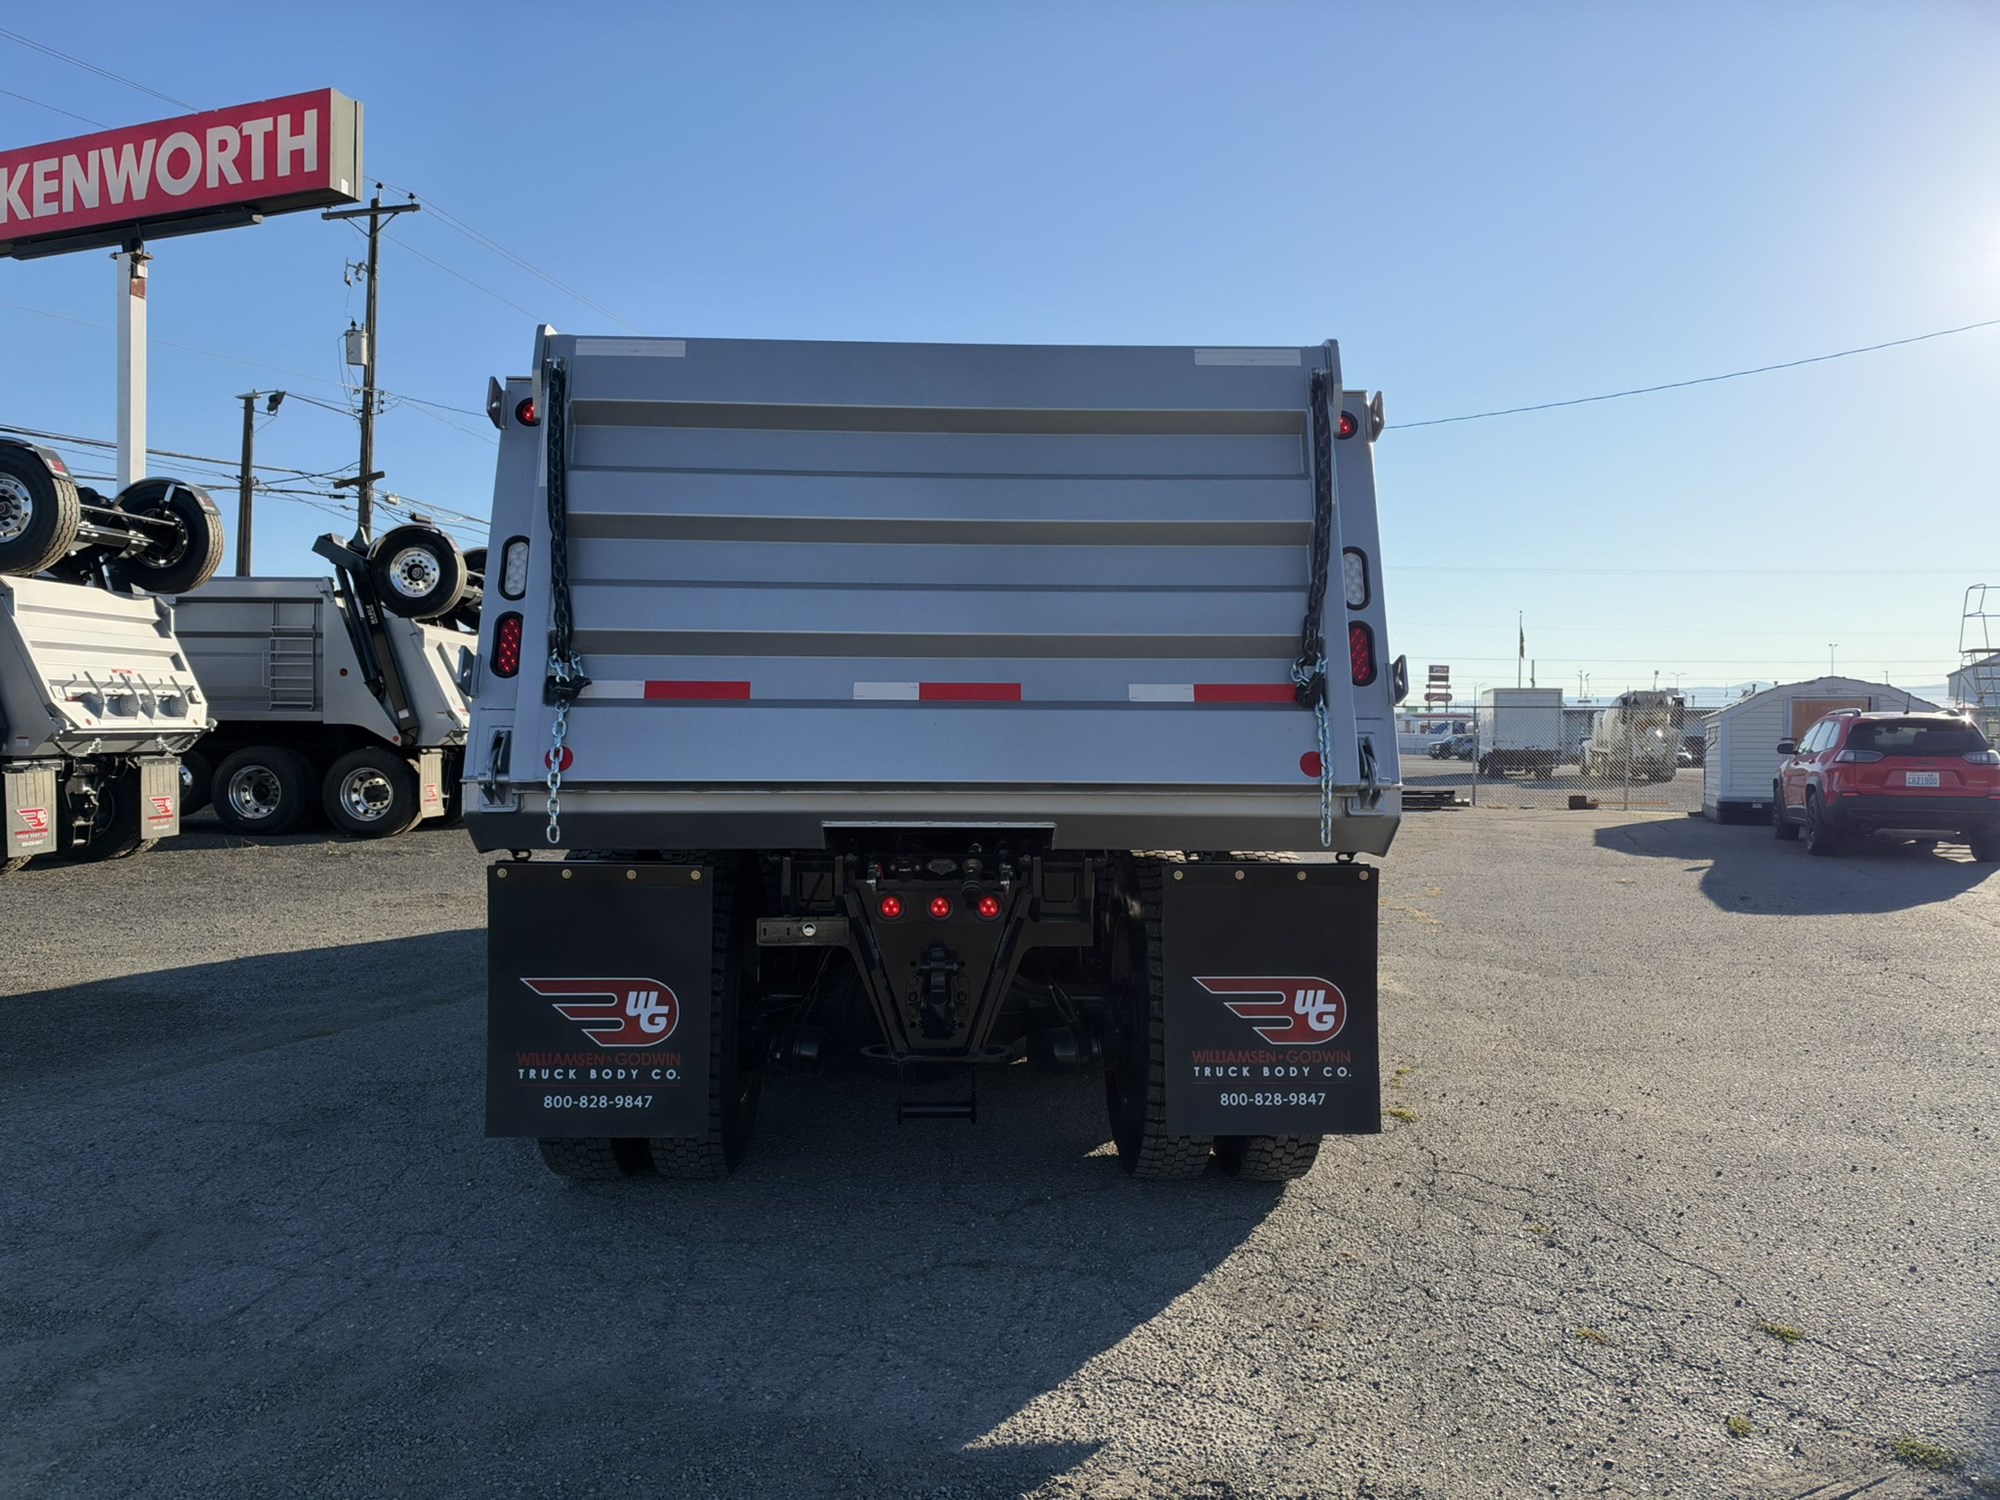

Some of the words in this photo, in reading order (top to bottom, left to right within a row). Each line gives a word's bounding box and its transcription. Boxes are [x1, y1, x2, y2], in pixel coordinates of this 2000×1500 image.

[0, 108, 319, 224] KENWORTH
[518, 1068, 577, 1080] TRUCK
[590, 1068, 639, 1080] BODY
[651, 1068, 681, 1080] CO.
[1193, 1066, 1250, 1077] TRUCK
[1263, 1066, 1311, 1077] BODY
[1323, 1066, 1352, 1077] CO.
[543, 1095, 653, 1108] 800-828-9847
[1220, 1092, 1326, 1106] 800-828-9847
